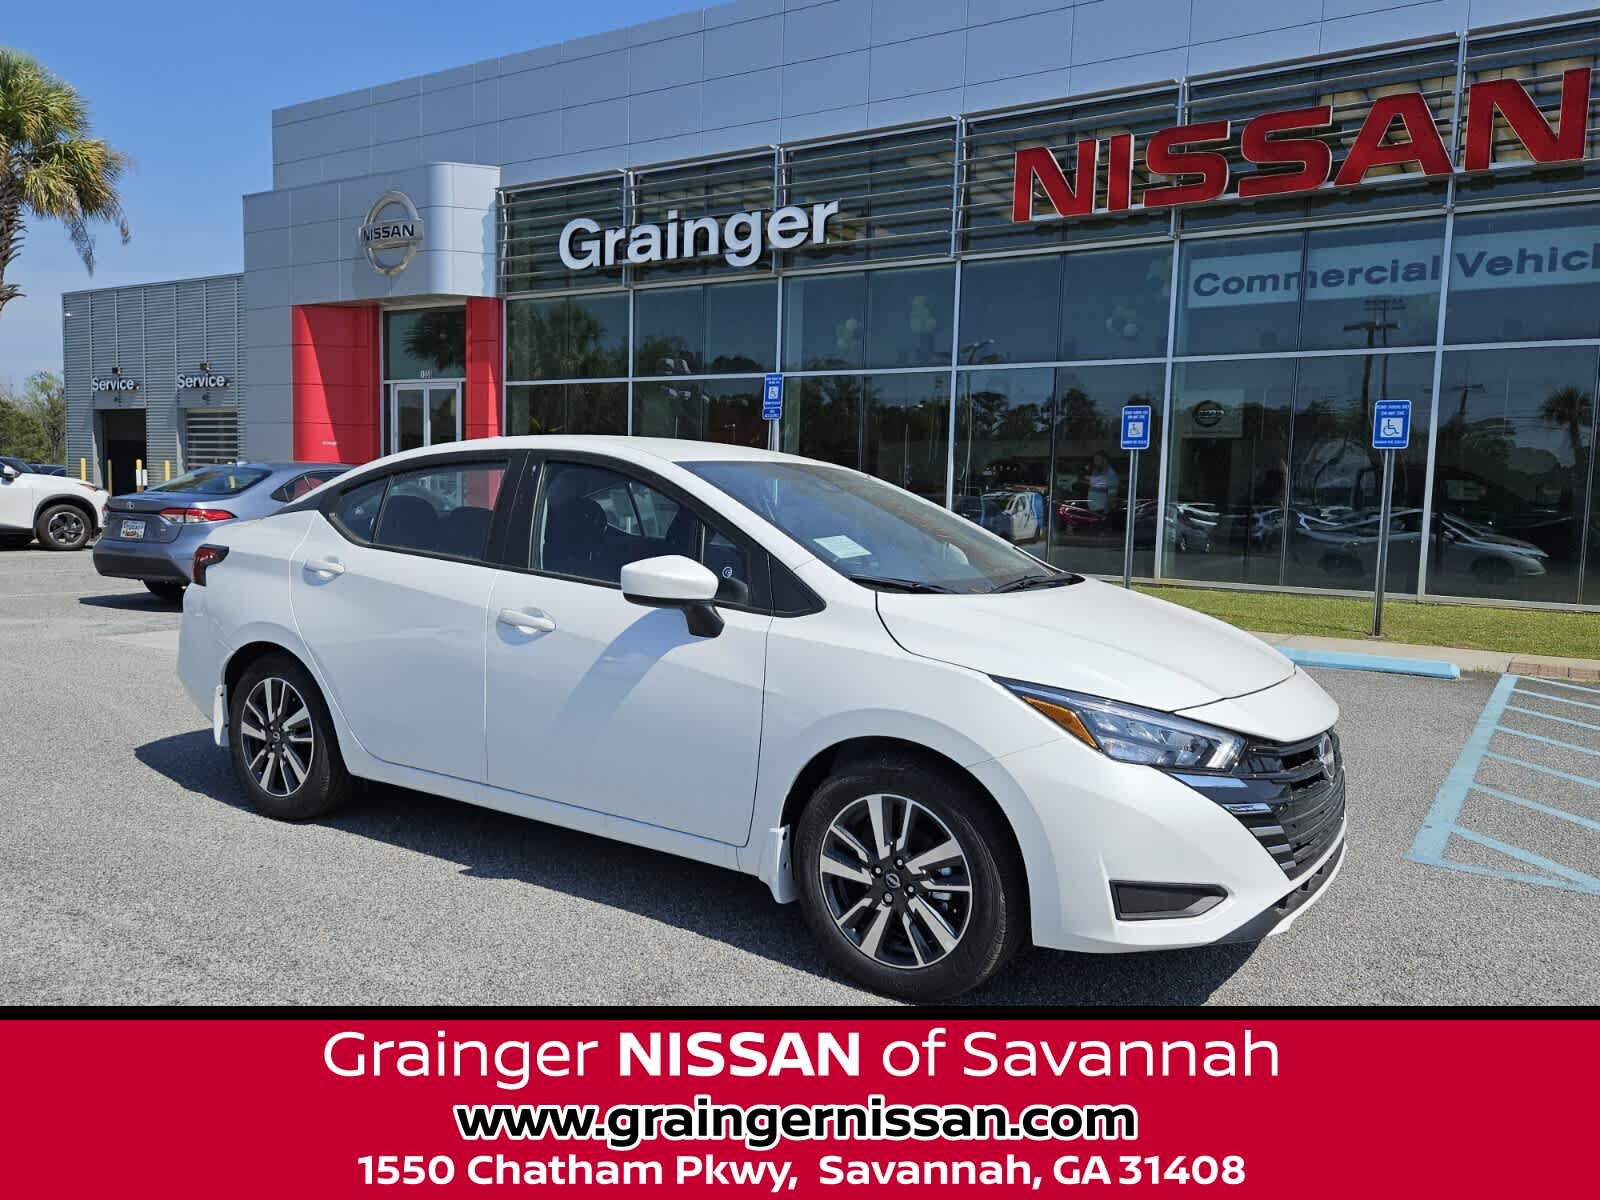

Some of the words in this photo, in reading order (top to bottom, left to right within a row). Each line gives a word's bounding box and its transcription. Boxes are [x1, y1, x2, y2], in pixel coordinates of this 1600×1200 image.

[1012, 67, 1591, 223] NISSAN
[363, 223, 415, 241] NISSAN
[559, 201, 839, 268] Grainger
[1193, 254, 1441, 298] Commercial
